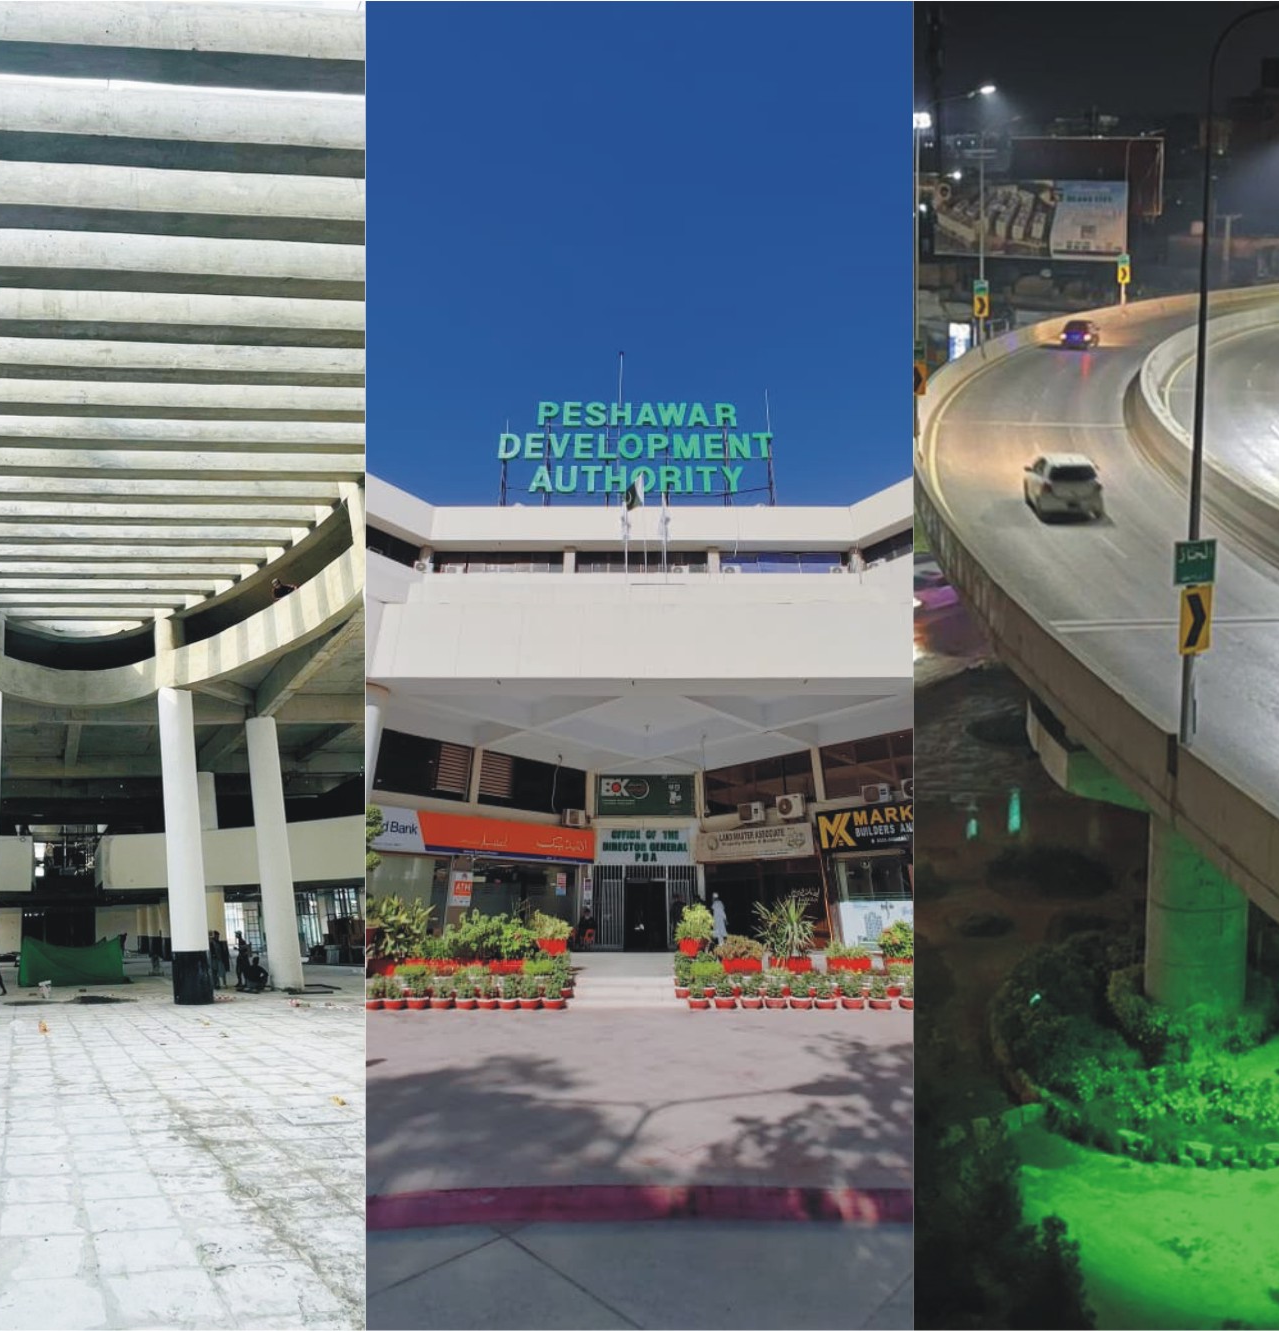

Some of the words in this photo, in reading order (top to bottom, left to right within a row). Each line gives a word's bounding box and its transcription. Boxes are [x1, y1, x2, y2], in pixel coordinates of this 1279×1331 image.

[537, 401, 738, 427] PESHAWAR
[497, 432, 773, 460] DEVELOPMENT
[528, 464, 743, 493] AUTHORITY
[390, 821, 418, 834] Bank
[855, 823, 895, 837] BUILDERS
[611, 831, 641, 839] OFFICE
[646, 831, 656, 839] OF
[663, 831, 679, 839] THE
[602, 842, 647, 851] DIRECTOR
[649, 842, 688, 851] GENERAL
